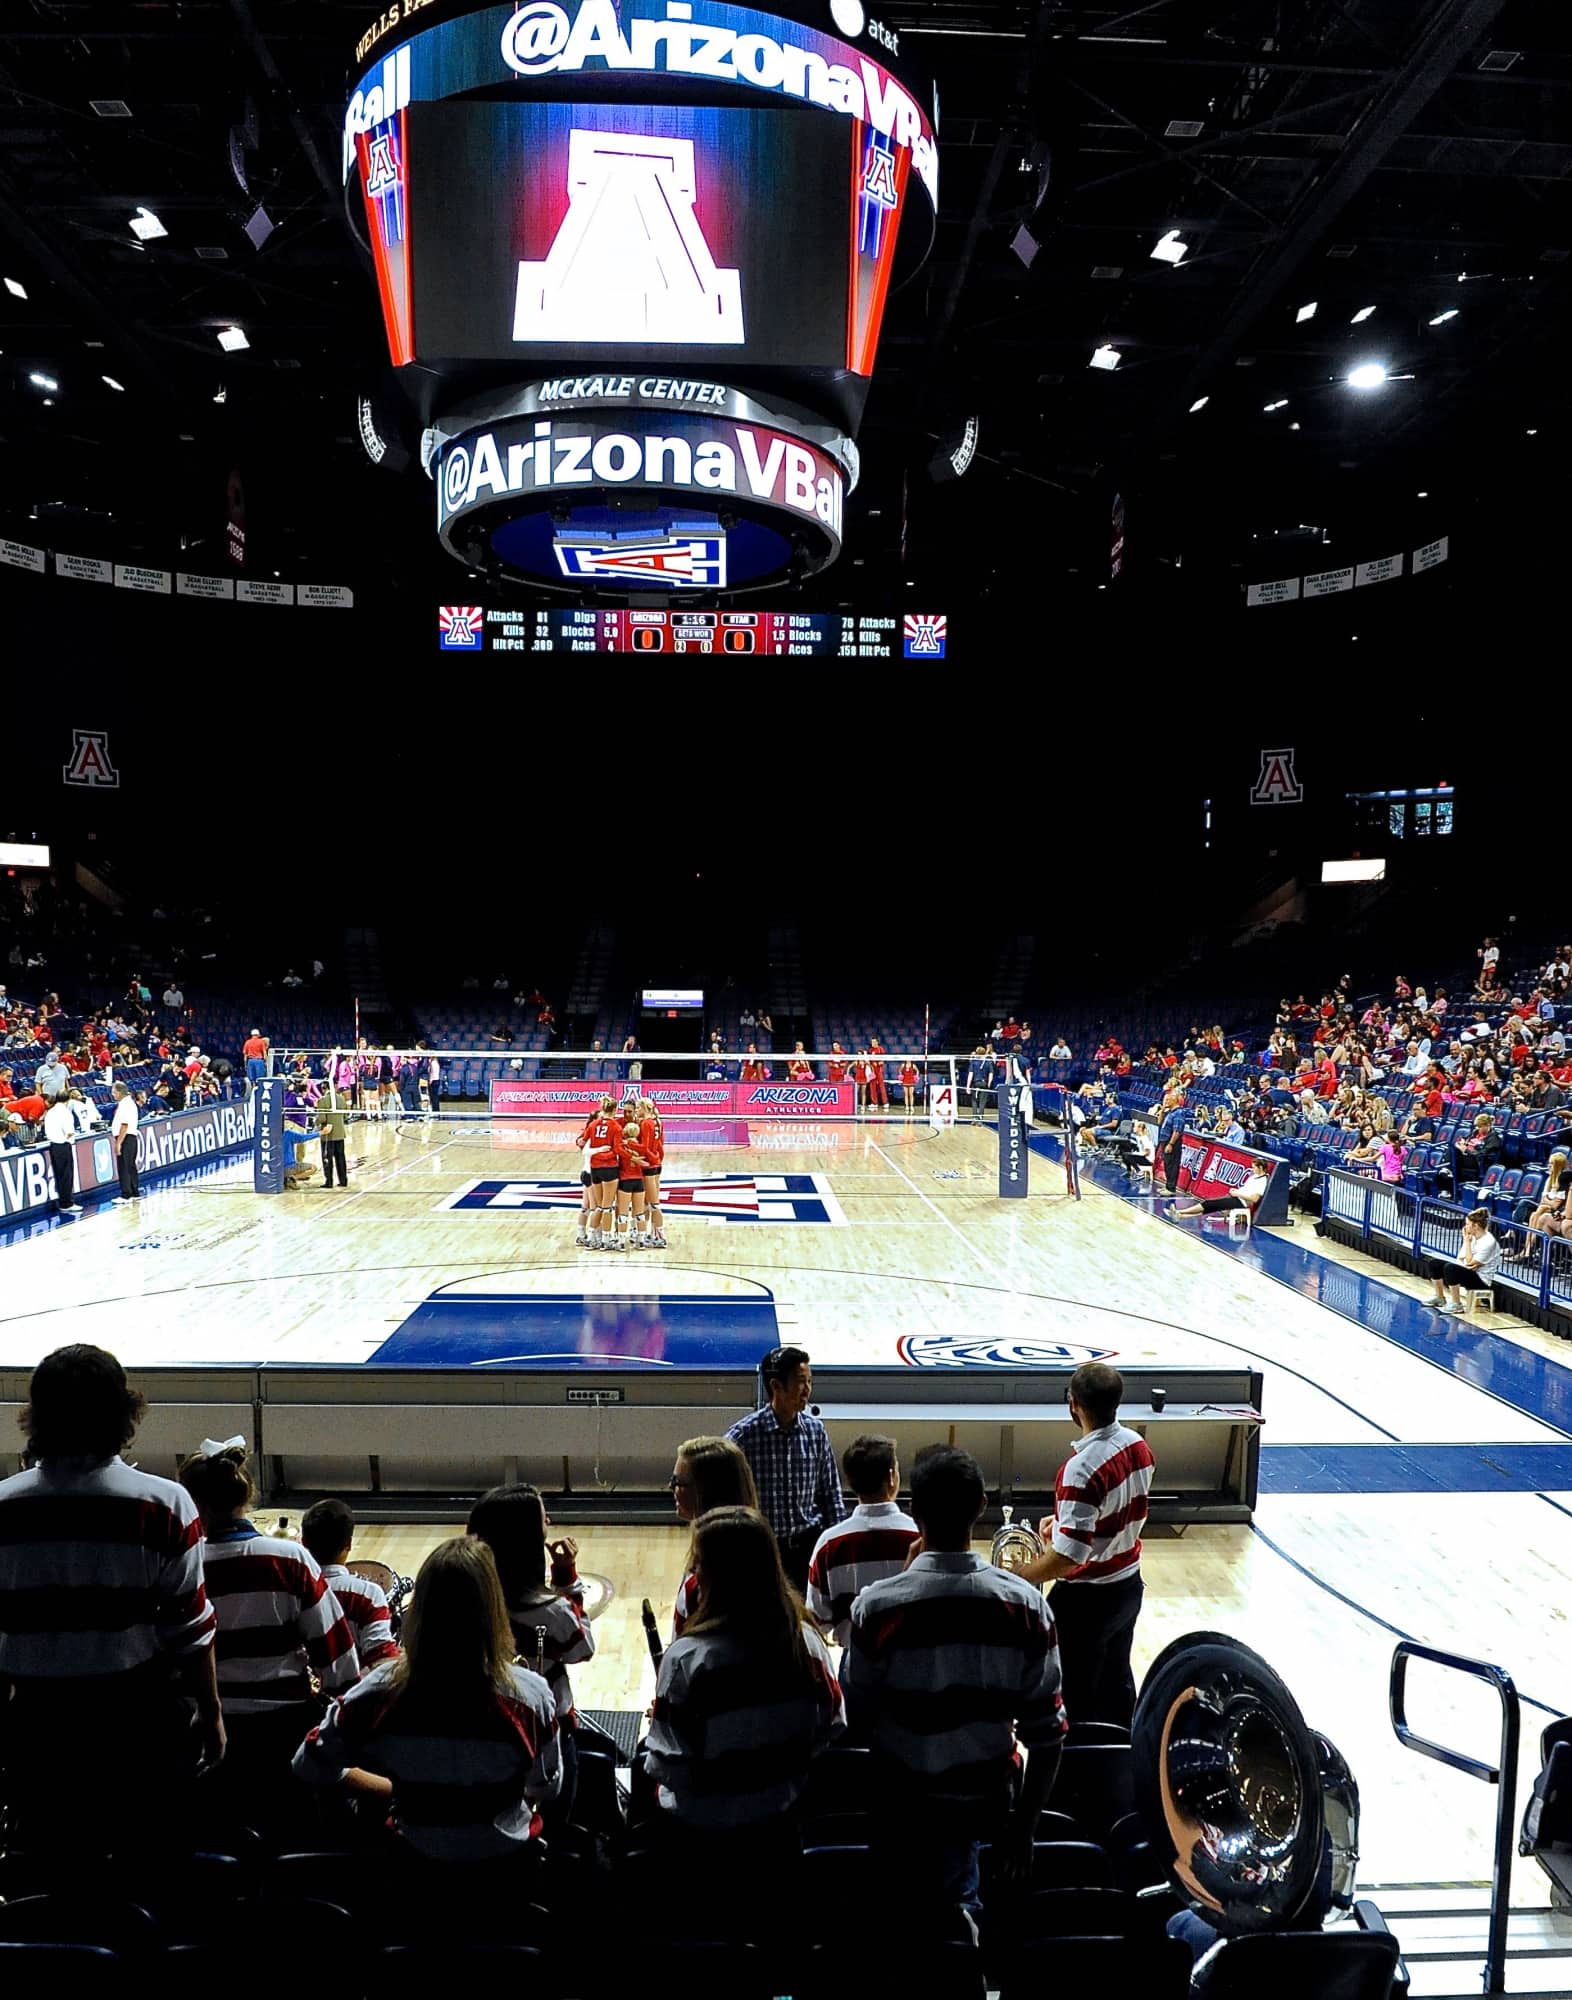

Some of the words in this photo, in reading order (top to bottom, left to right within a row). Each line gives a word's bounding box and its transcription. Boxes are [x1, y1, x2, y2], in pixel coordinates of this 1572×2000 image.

[355, 3, 400, 63] WELLS
[868, 18, 899, 57] at&t
[501, 0, 938, 215] @ArizonaVBal
[367, 135, 397, 197] A
[864, 146, 898, 208] A
[538, 377, 632, 401] MCKALE
[639, 378, 728, 405] CENTER
[487, 611, 524, 622] Attacks
[574, 612, 596, 624] Digs
[681, 615, 706, 625] 1:16
[773, 616, 785, 627] 37
[789, 616, 811, 628] Digs
[859, 617, 896, 629] Attacks
[503, 625, 525, 636] Kills
[536, 626, 548, 637] 32
[562, 626, 595, 637] Blocks
[641, 629, 654, 649] 0
[773, 630, 785, 641] 1.5
[789, 630, 822, 641] Blocks
[842, 632, 854, 642] 24
[859, 631, 881, 643] Kills
[572, 640, 596, 651] Aces
[734, 631, 745, 650] 0
[788, 644, 813, 655] Aces
[63, 729, 119, 787] A
[1251, 748, 1304, 805] A
[747, 1086, 839, 1104] ARIZONA
[260, 1090, 272, 1174] ARIZONA
[595, 1125, 608, 1138] 12
[1008, 1096, 1019, 1181] WILDCATS
